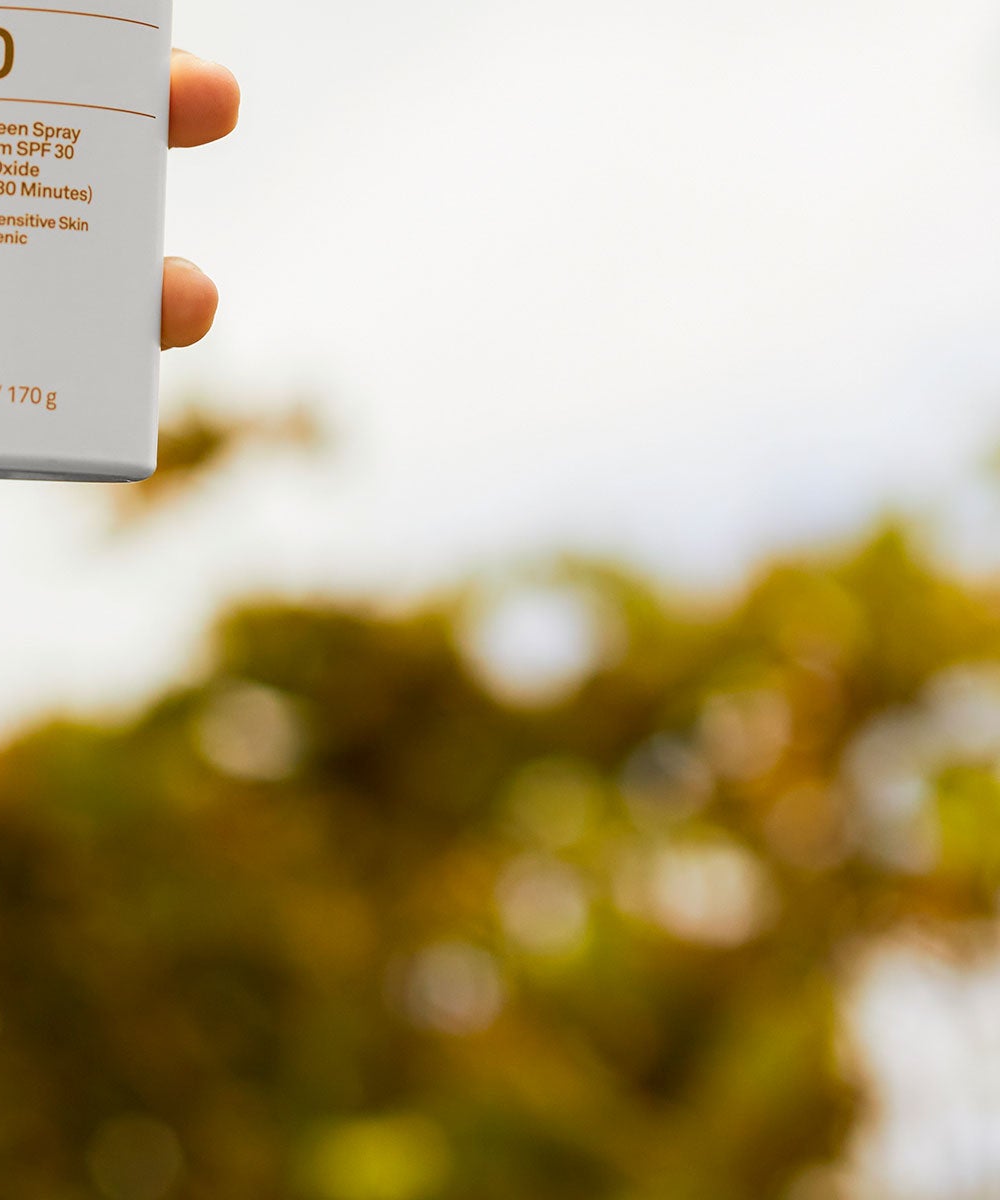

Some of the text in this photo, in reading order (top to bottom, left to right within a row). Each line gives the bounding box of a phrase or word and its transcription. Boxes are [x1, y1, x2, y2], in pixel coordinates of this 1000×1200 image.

[32, 122, 81, 144] Spray
[16, 141, 51, 158] SPF
[54, 144, 74, 160] 30
[20, 181, 93, 205] Minutes)
[58, 215, 89, 232] Skin
[8, 386, 42, 405] 170
[45, 391, 57, 411] g
